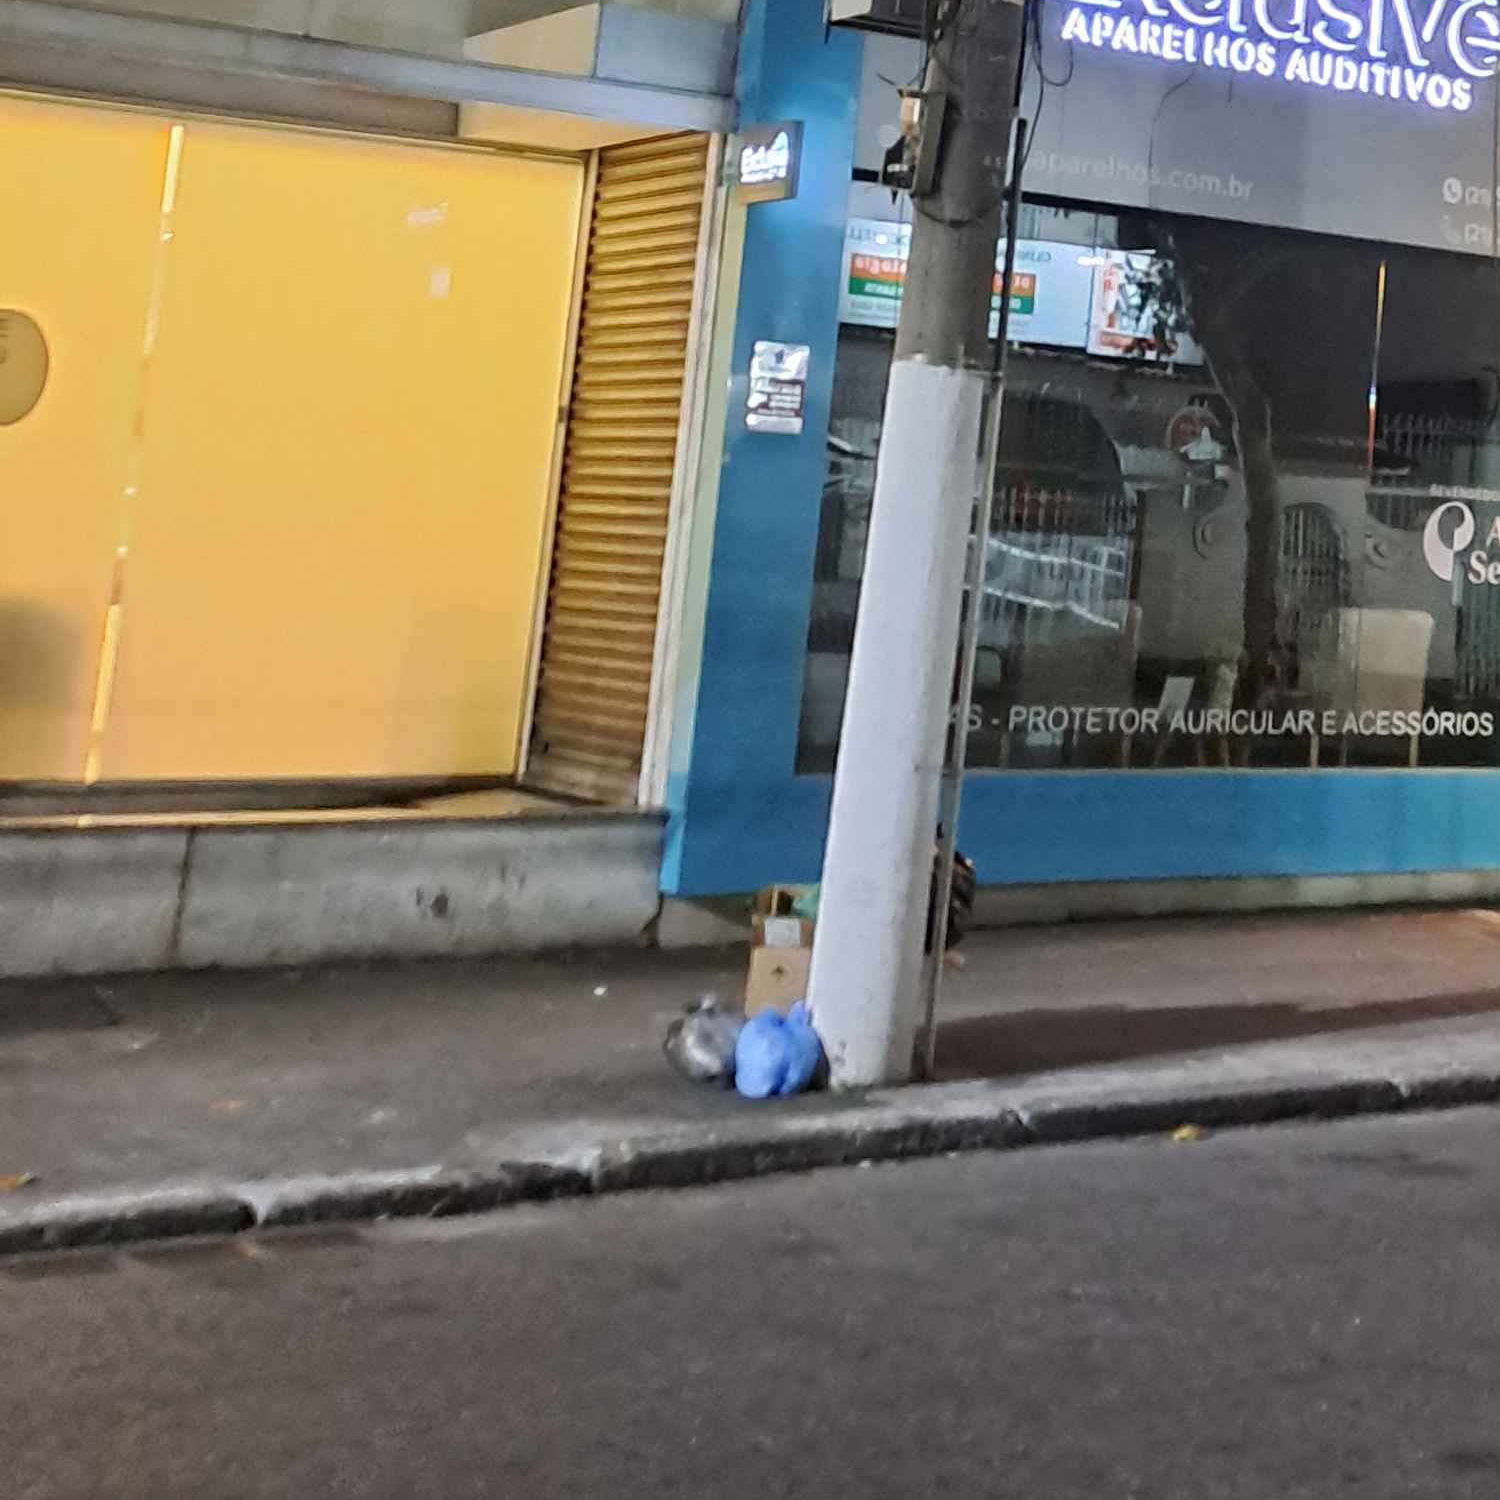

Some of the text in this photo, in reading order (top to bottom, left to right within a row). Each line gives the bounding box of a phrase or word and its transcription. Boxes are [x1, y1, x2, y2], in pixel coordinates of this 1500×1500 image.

[1284, 48, 1472, 112] AUDITIVOS
[1009, 705, 1159, 734] PROTETOR
[1169, 707, 1314, 736] AURICULAR
[1321, 710, 1337, 735] E
[1342, 706, 1494, 737] ACESSÓRIOS
